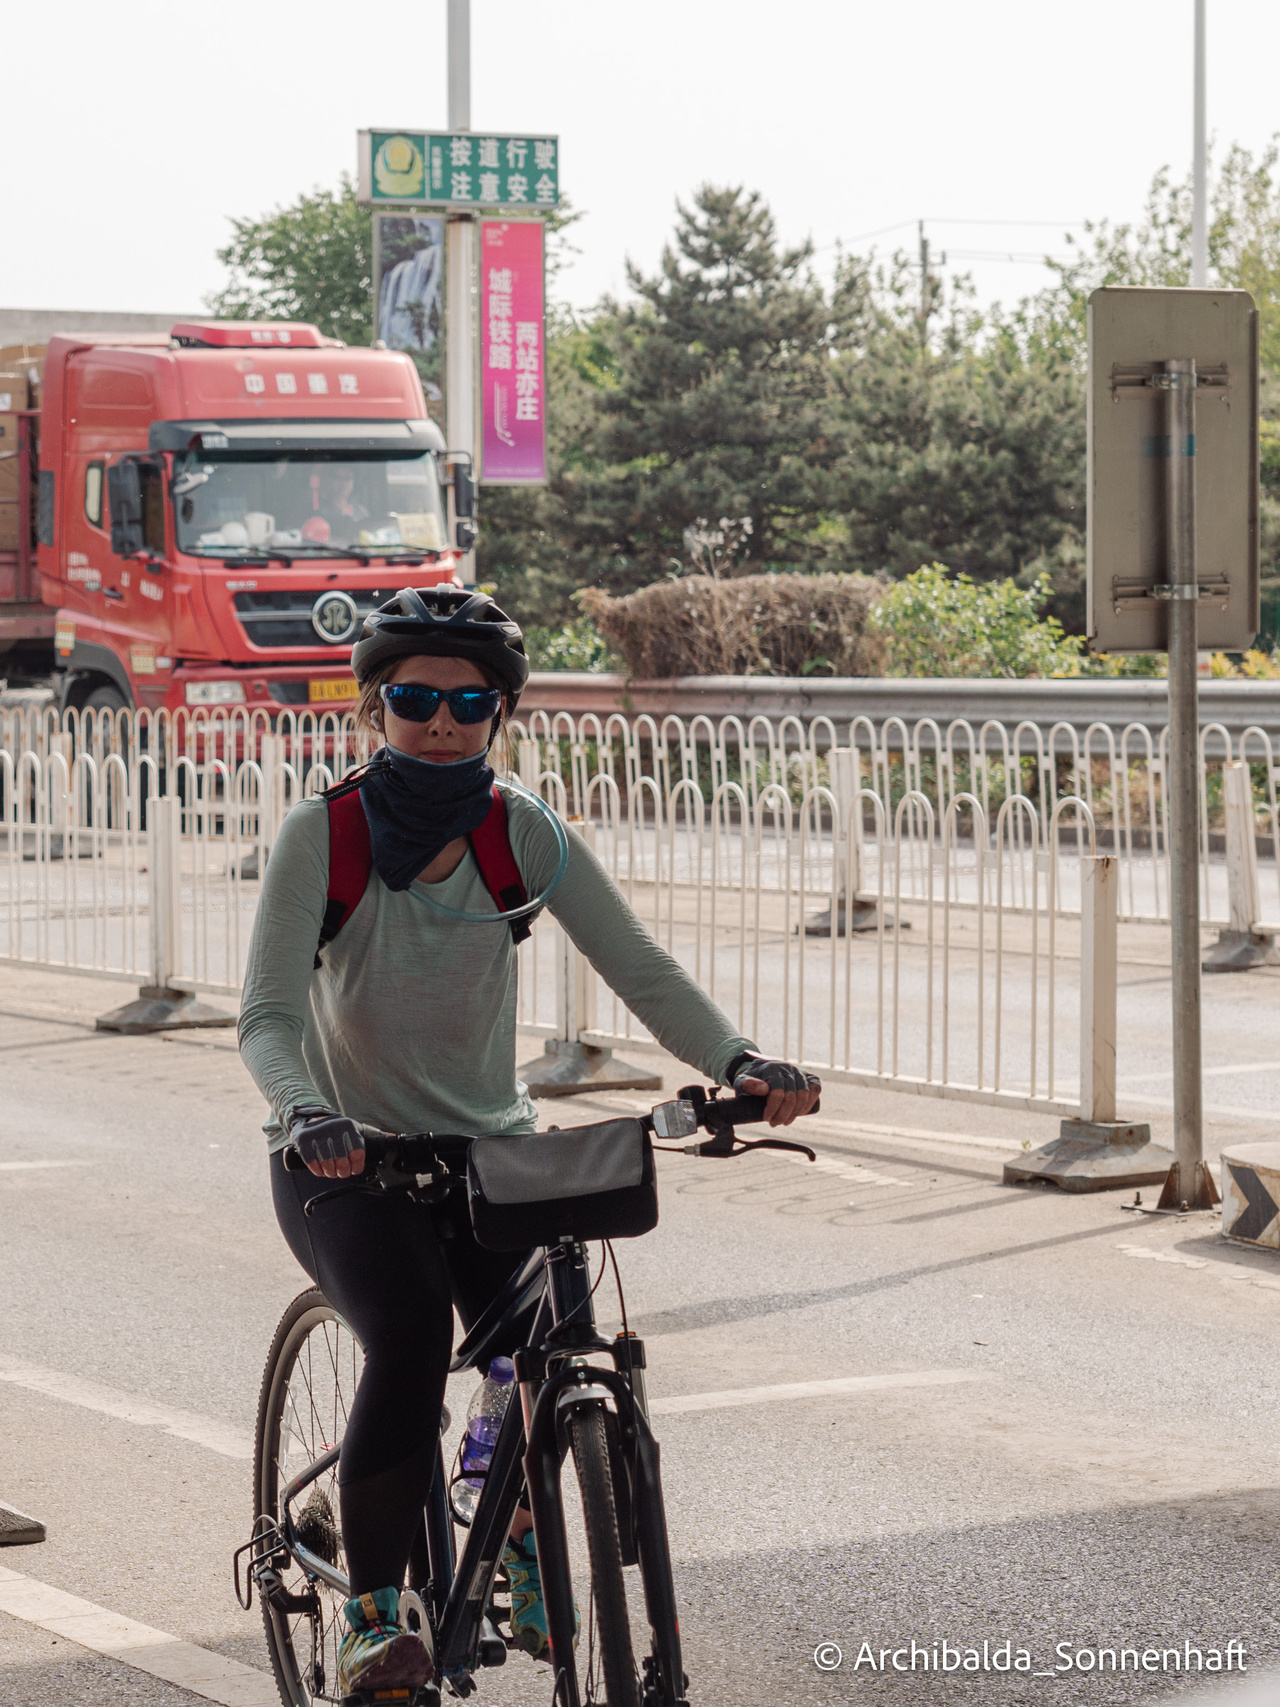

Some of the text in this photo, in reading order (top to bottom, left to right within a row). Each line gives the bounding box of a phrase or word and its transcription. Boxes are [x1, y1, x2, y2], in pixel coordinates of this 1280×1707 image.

[449, 136, 556, 170] 按道行驶
[450, 171, 556, 202] 注意安全
[488, 267, 513, 370] 城际铁路
[515, 320, 540, 421] 两站亦庄
